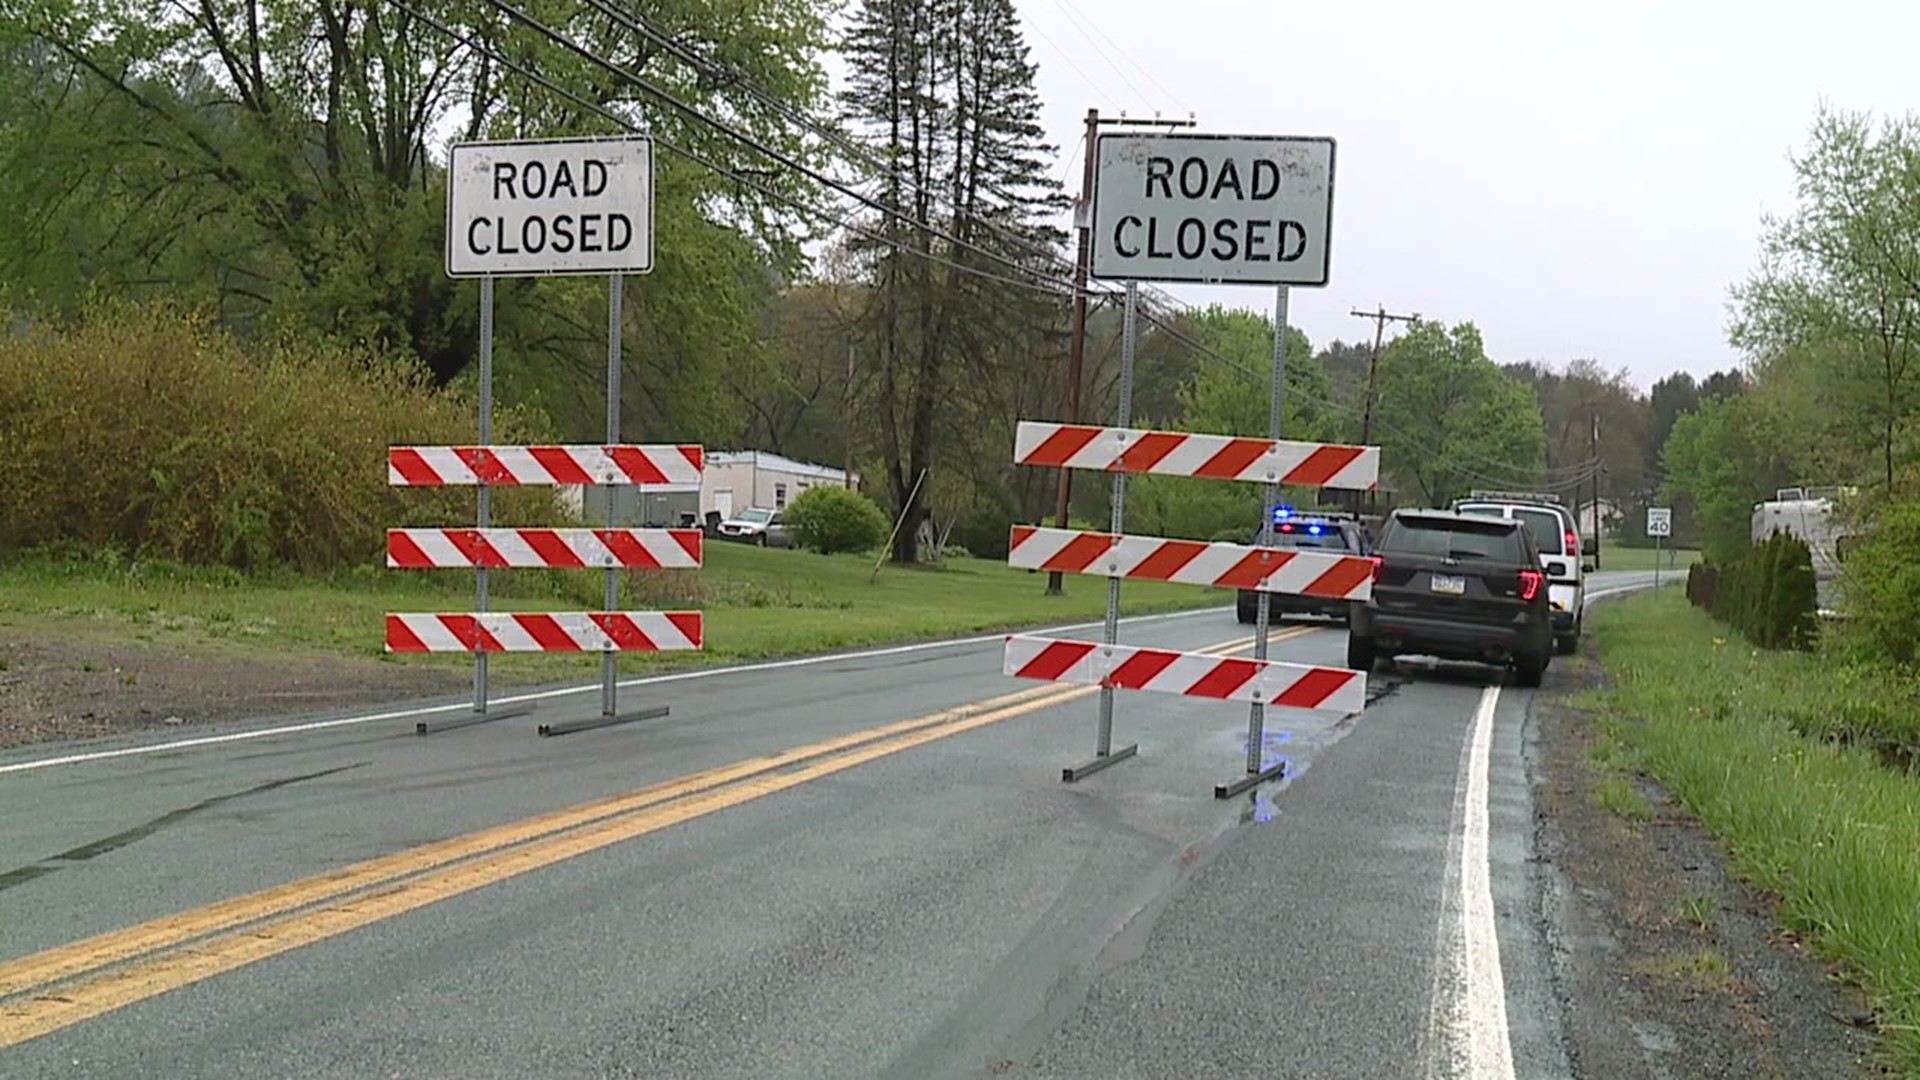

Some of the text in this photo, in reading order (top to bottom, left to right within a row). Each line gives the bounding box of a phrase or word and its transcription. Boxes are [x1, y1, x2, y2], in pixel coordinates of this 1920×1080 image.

[494, 160, 608, 200] ROAD
[1145, 156, 1281, 200] ROAD
[468, 213, 632, 255] CLOSED
[1113, 215, 1307, 262] CLOSED
[1650, 522, 1669, 533] 40
